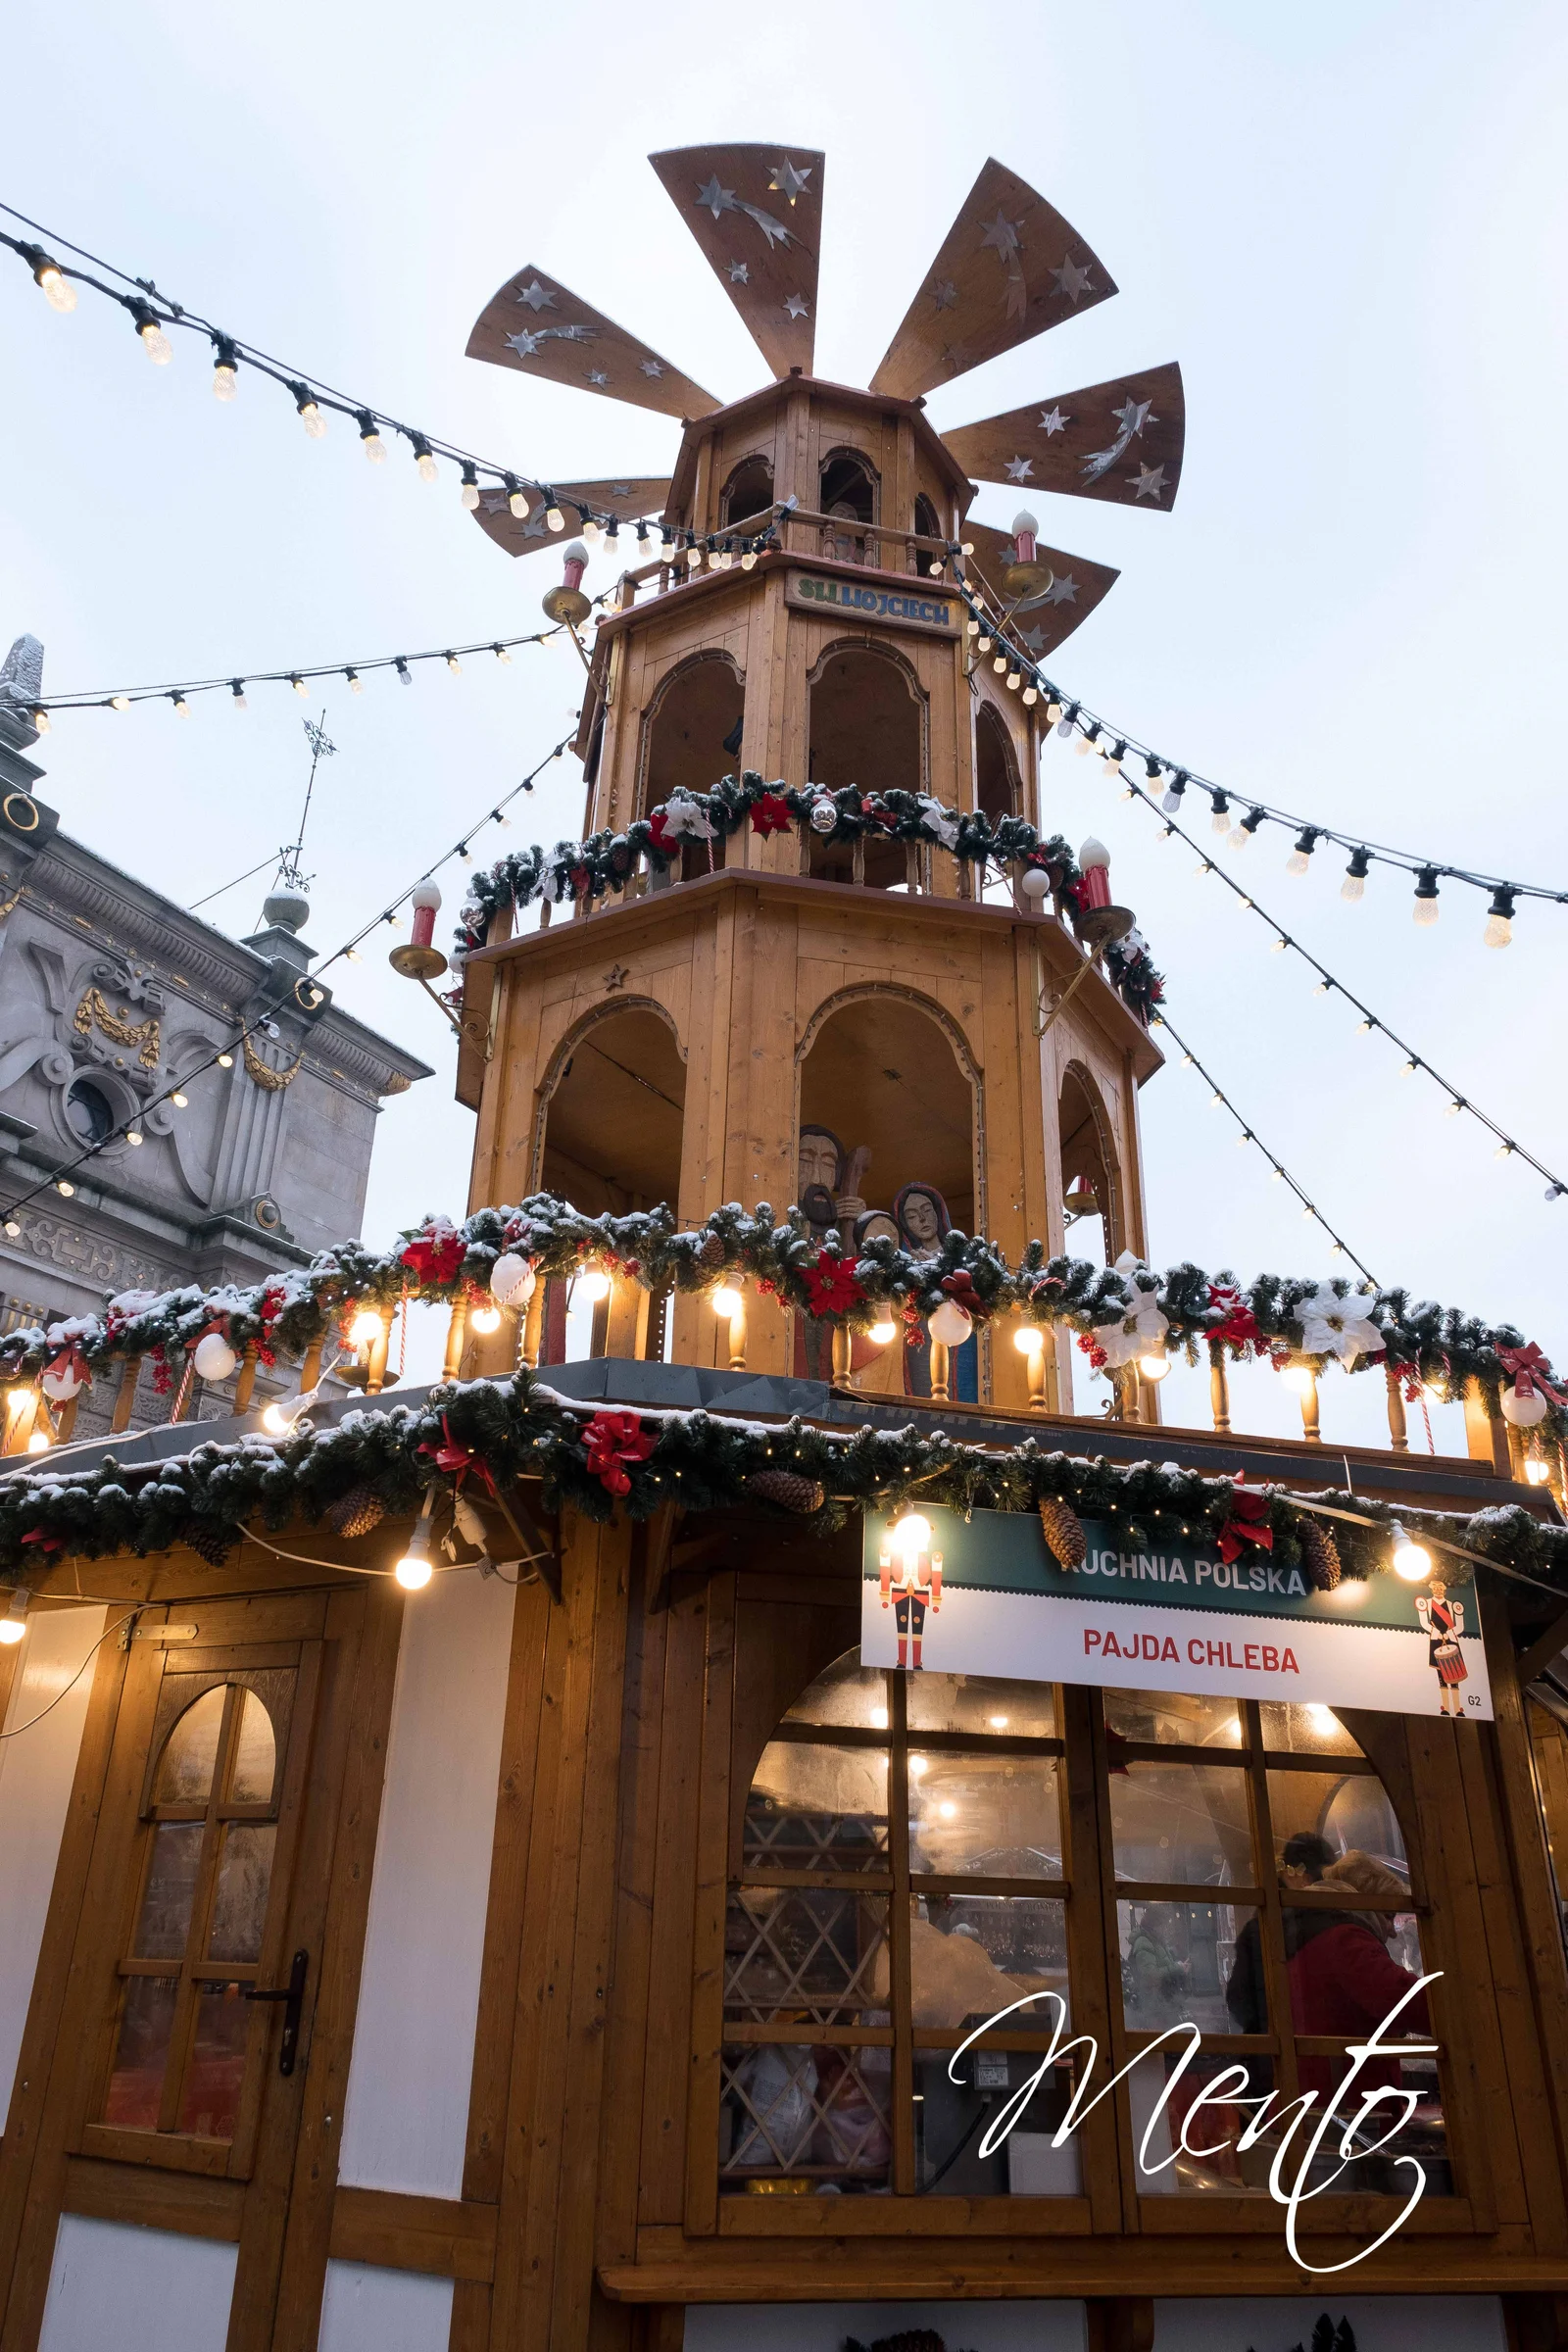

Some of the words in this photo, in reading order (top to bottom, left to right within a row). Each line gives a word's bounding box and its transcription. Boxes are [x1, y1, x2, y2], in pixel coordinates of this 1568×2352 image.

[841, 586, 950, 625] WOJCIECH
[1060, 1549, 1188, 1584] UCHNIA
[1194, 1559, 1306, 1596] POLSKA
[1083, 1629, 1181, 1663] PAJDA
[1187, 1639, 1300, 1674] CHLEBA
[1467, 1694, 1482, 1706] G2
